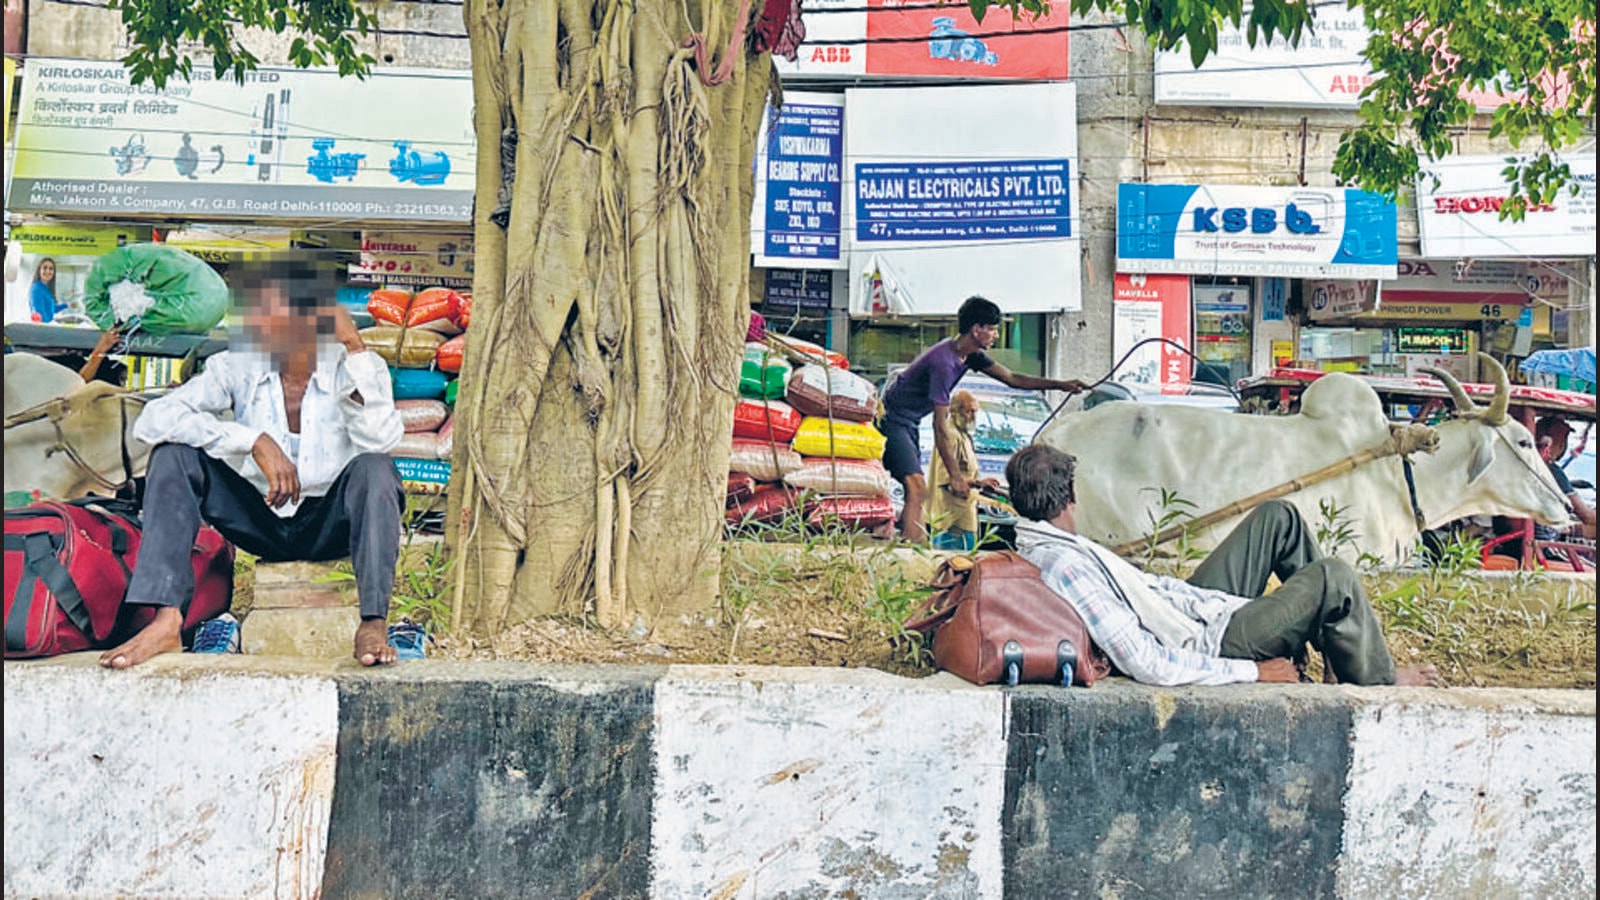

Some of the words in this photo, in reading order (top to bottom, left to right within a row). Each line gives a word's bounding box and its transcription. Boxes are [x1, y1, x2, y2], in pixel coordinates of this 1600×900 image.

[1334, 20, 1361, 31] Ltd.
[811, 47, 851, 63] ABB
[38, 67, 124, 79] KIRLOSKAR
[36, 82, 45, 92] A
[47, 82, 96, 93] Kirloskar
[99, 82, 134, 97] Group
[31, 181, 95, 193] Athorised
[98, 183, 138, 194] Dealer
[859, 179, 904, 199] RAJAN
[908, 177, 1000, 199] ELECTRICALS
[1004, 176, 1034, 197] PVT.
[1037, 175, 1067, 196] LTD.
[30, 194, 56, 205] M/s.
[60, 195, 106, 206] Jakson
[110, 196, 119, 206] &
[123, 196, 186, 210] Company,
[243, 200, 277, 211] Road
[1193, 206, 1277, 234] KSB
[870, 223, 892, 238] 47,
[1231, 241, 1265, 250] German
[1268, 242, 1316, 253] Technology
[1119, 290, 1158, 298] HAVELLS
[1418, 306, 1452, 315] POWER
[1481, 303, 1502, 317] 46
